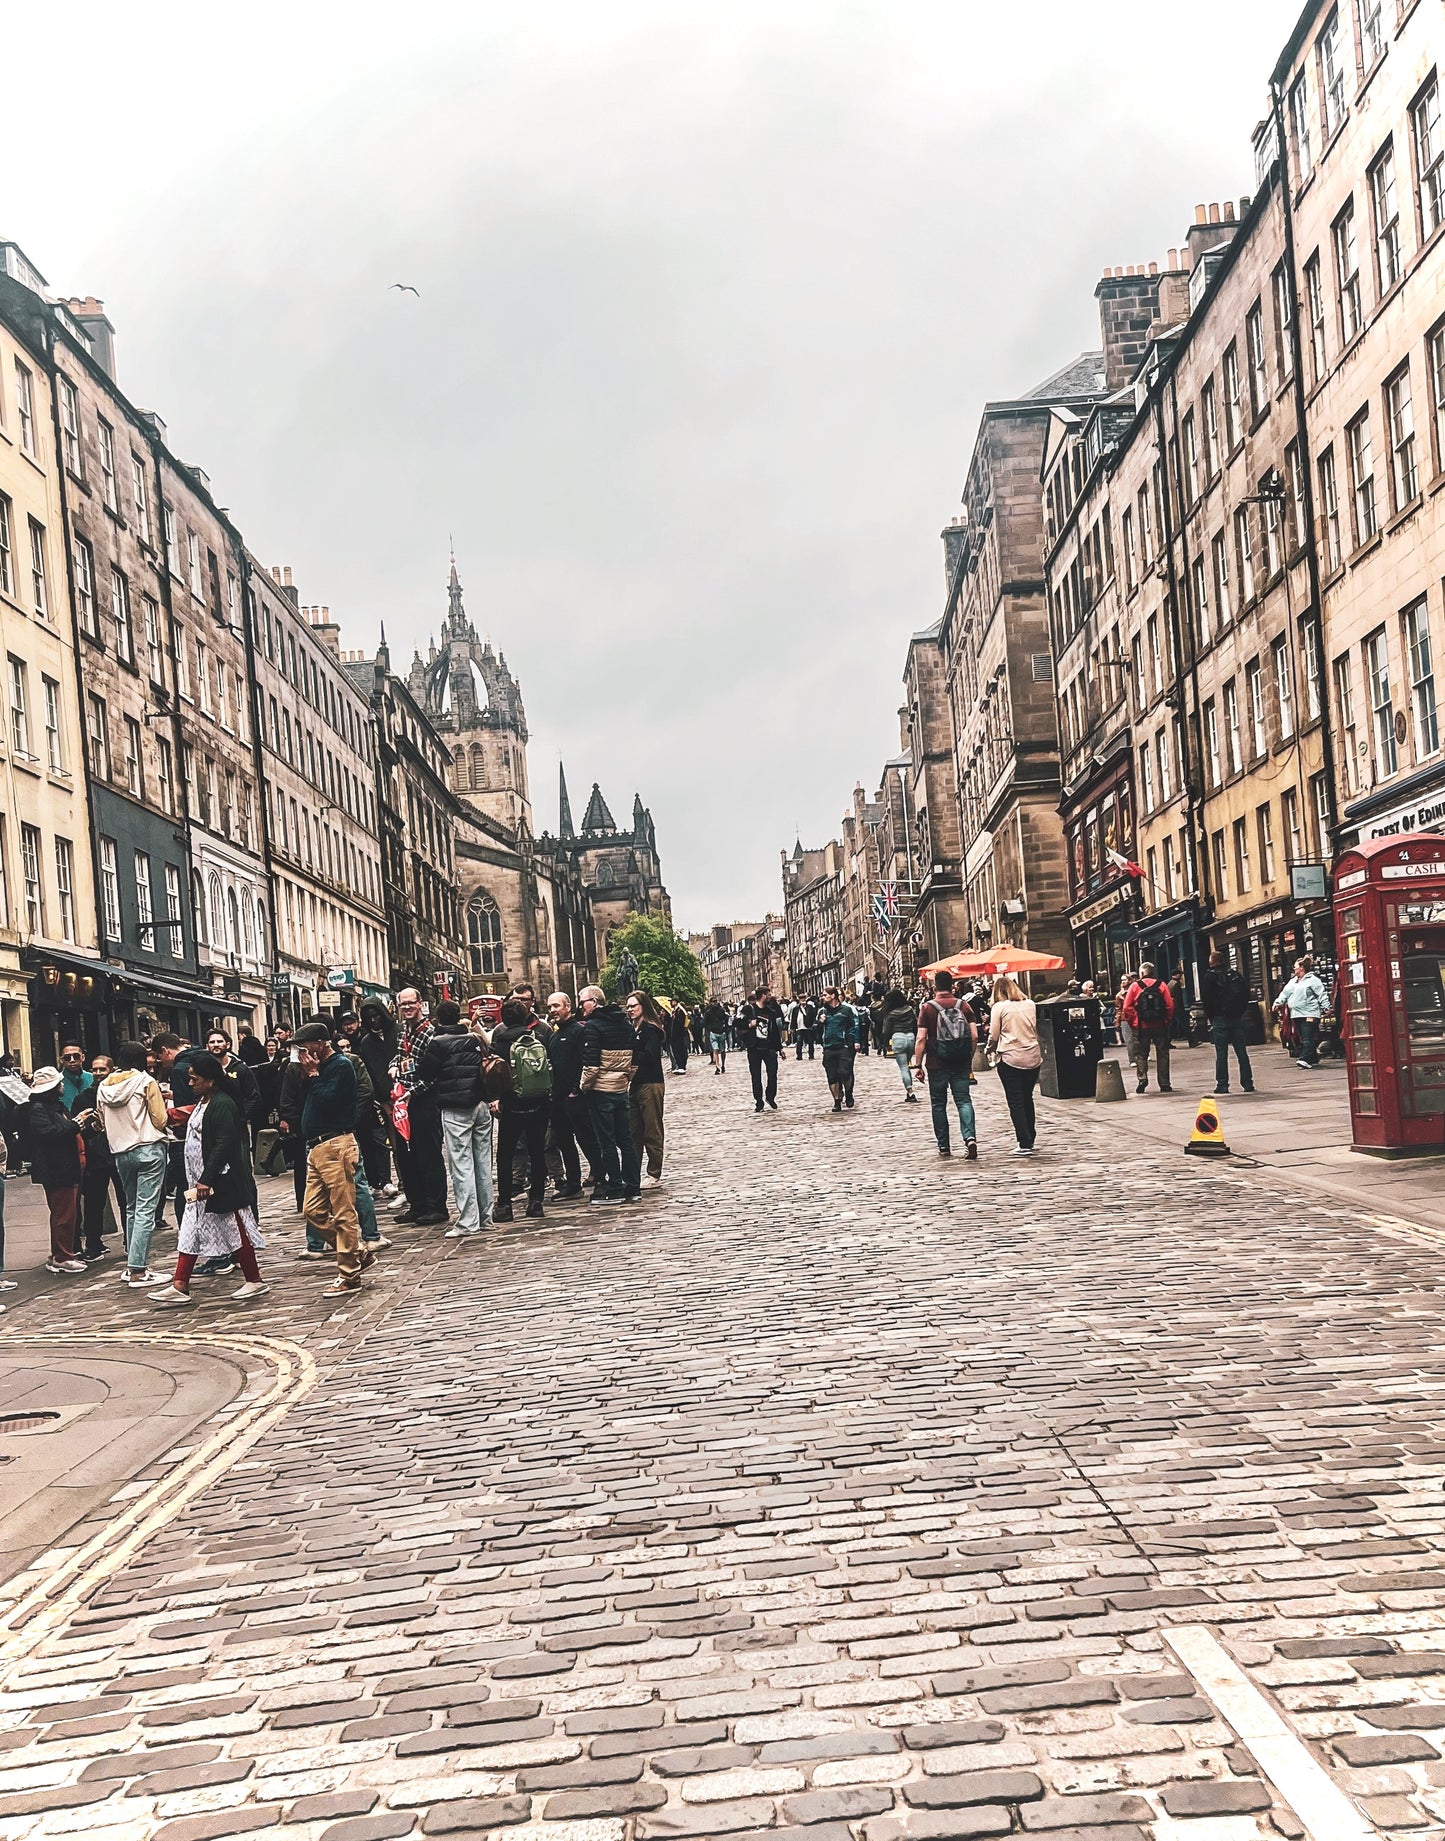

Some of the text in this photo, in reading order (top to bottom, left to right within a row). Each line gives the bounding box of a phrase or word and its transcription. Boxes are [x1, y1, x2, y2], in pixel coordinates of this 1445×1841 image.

[1402, 814, 1415, 831] OF
[1405, 863, 1438, 876] CASH
[273, 975, 288, 984] 166
